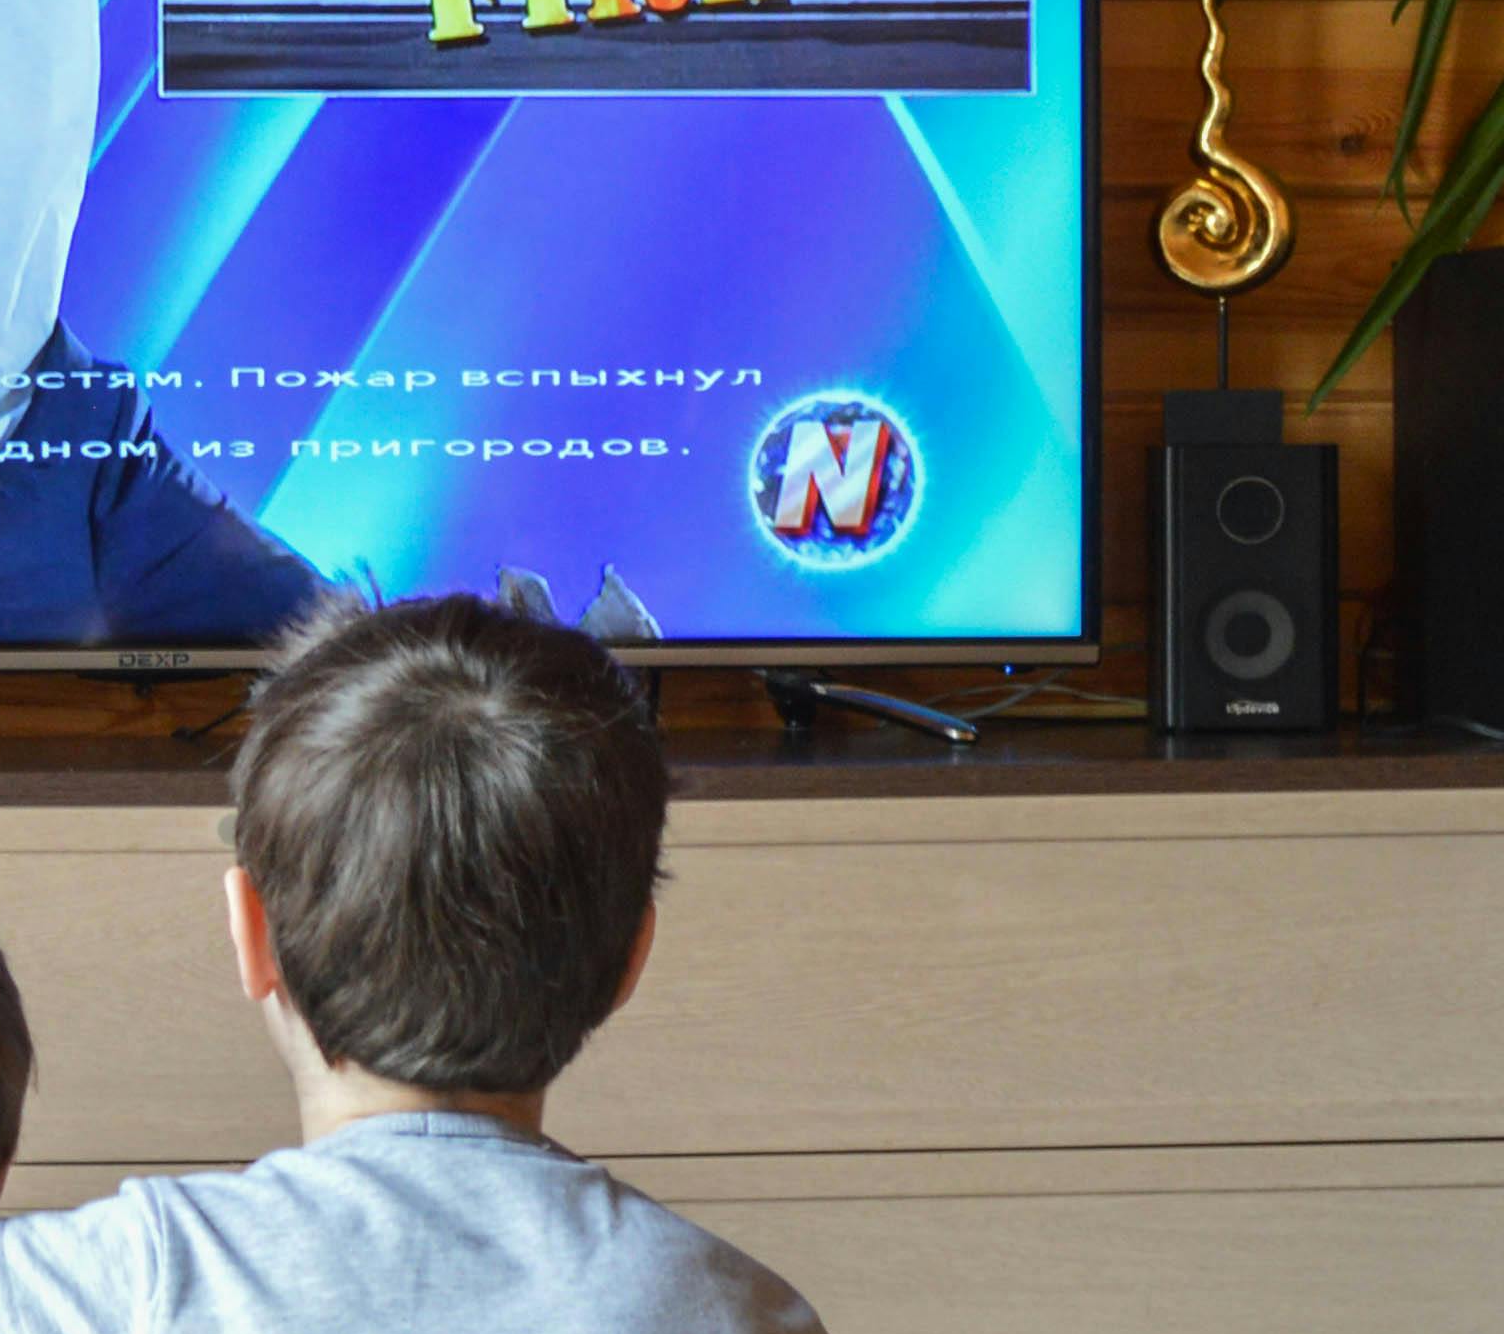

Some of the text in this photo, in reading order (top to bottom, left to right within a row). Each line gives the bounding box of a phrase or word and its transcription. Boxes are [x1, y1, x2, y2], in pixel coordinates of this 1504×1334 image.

[230, 366, 437, 393] Пожар
[461, 368, 764, 393] вспыхнул
[192, 439, 257, 459] из
[290, 438, 691, 464] пригородов.
[774, 420, 891, 535] N
[117, 652, 191, 668] DEXP
